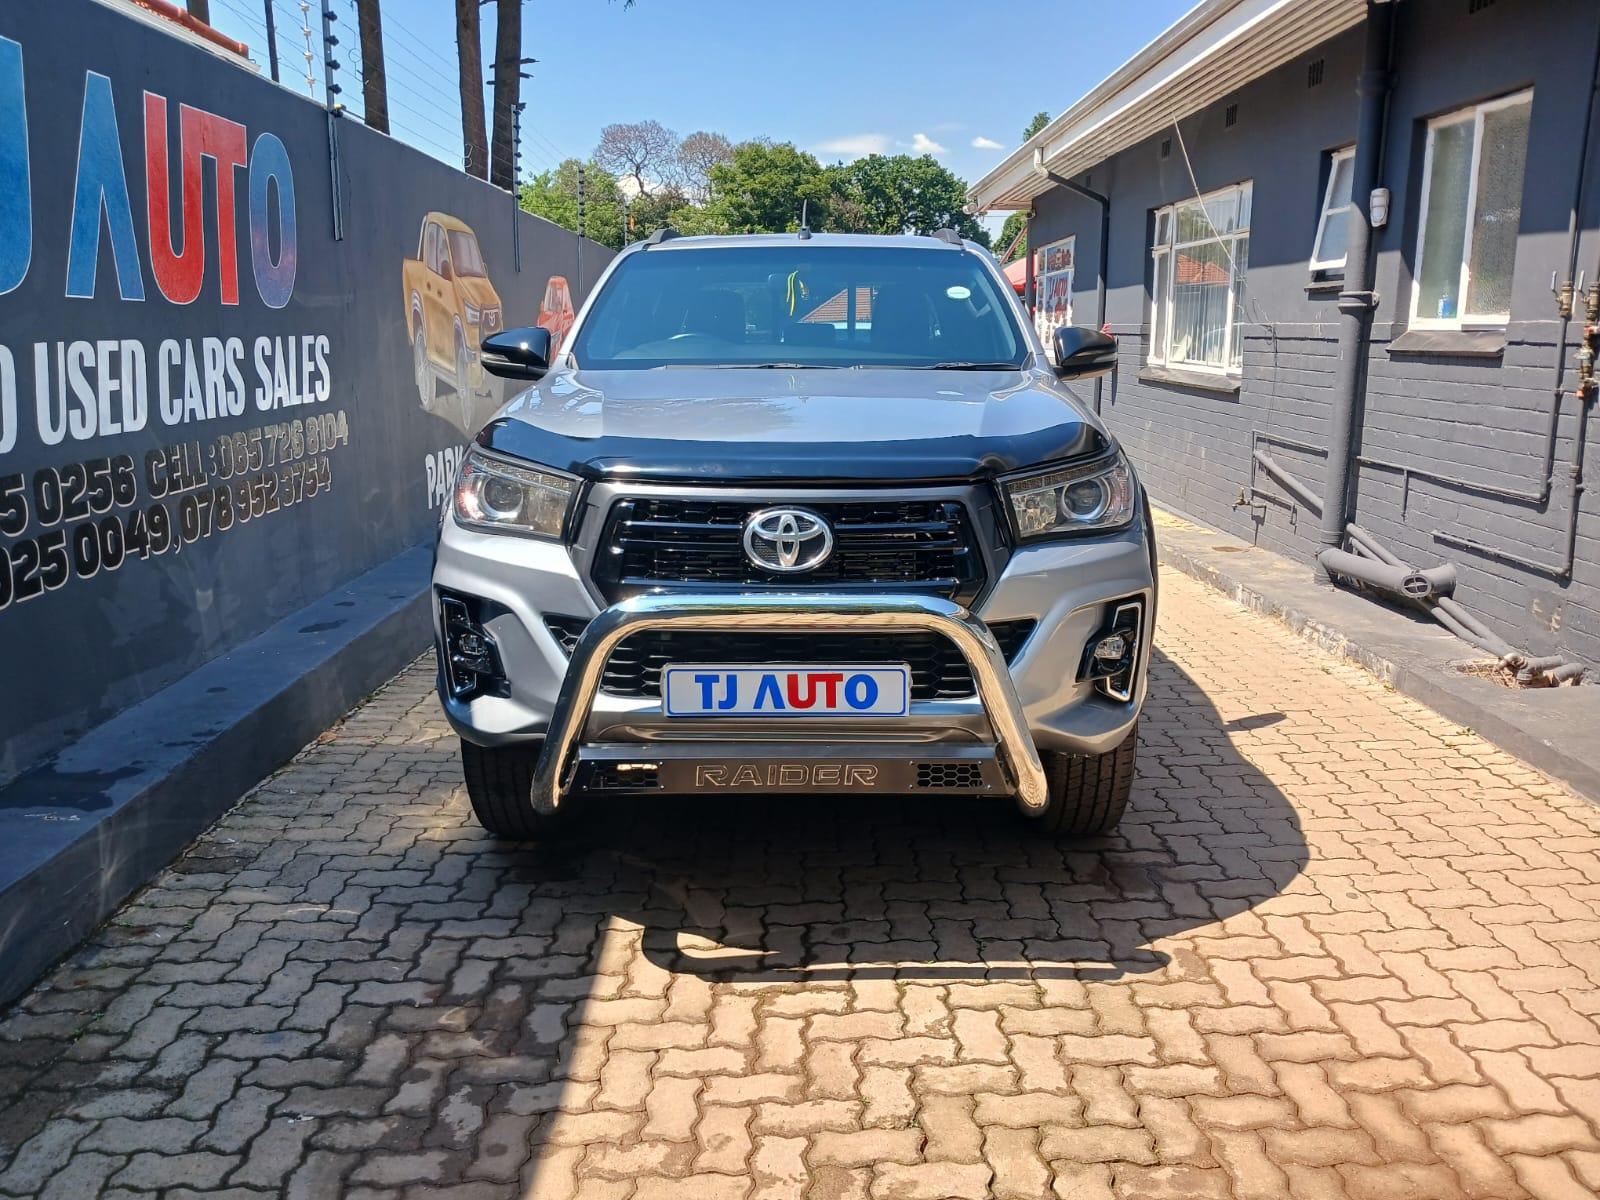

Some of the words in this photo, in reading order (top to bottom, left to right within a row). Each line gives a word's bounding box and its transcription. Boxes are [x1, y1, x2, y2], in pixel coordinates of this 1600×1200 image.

[65, 70, 296, 309] AUTO
[34, 339, 148, 445] USED
[159, 337, 245, 426] CARS
[254, 335, 330, 412] SALES
[33, 454, 137, 527] 0256
[263, 419, 304, 468] 726
[305, 410, 348, 455] 8104
[236, 471, 281, 524] 952
[280, 456, 332, 507] 3754
[694, 674, 737, 710] TJ
[752, 673, 879, 710] AUTO
[694, 763, 879, 788] RAIDER
